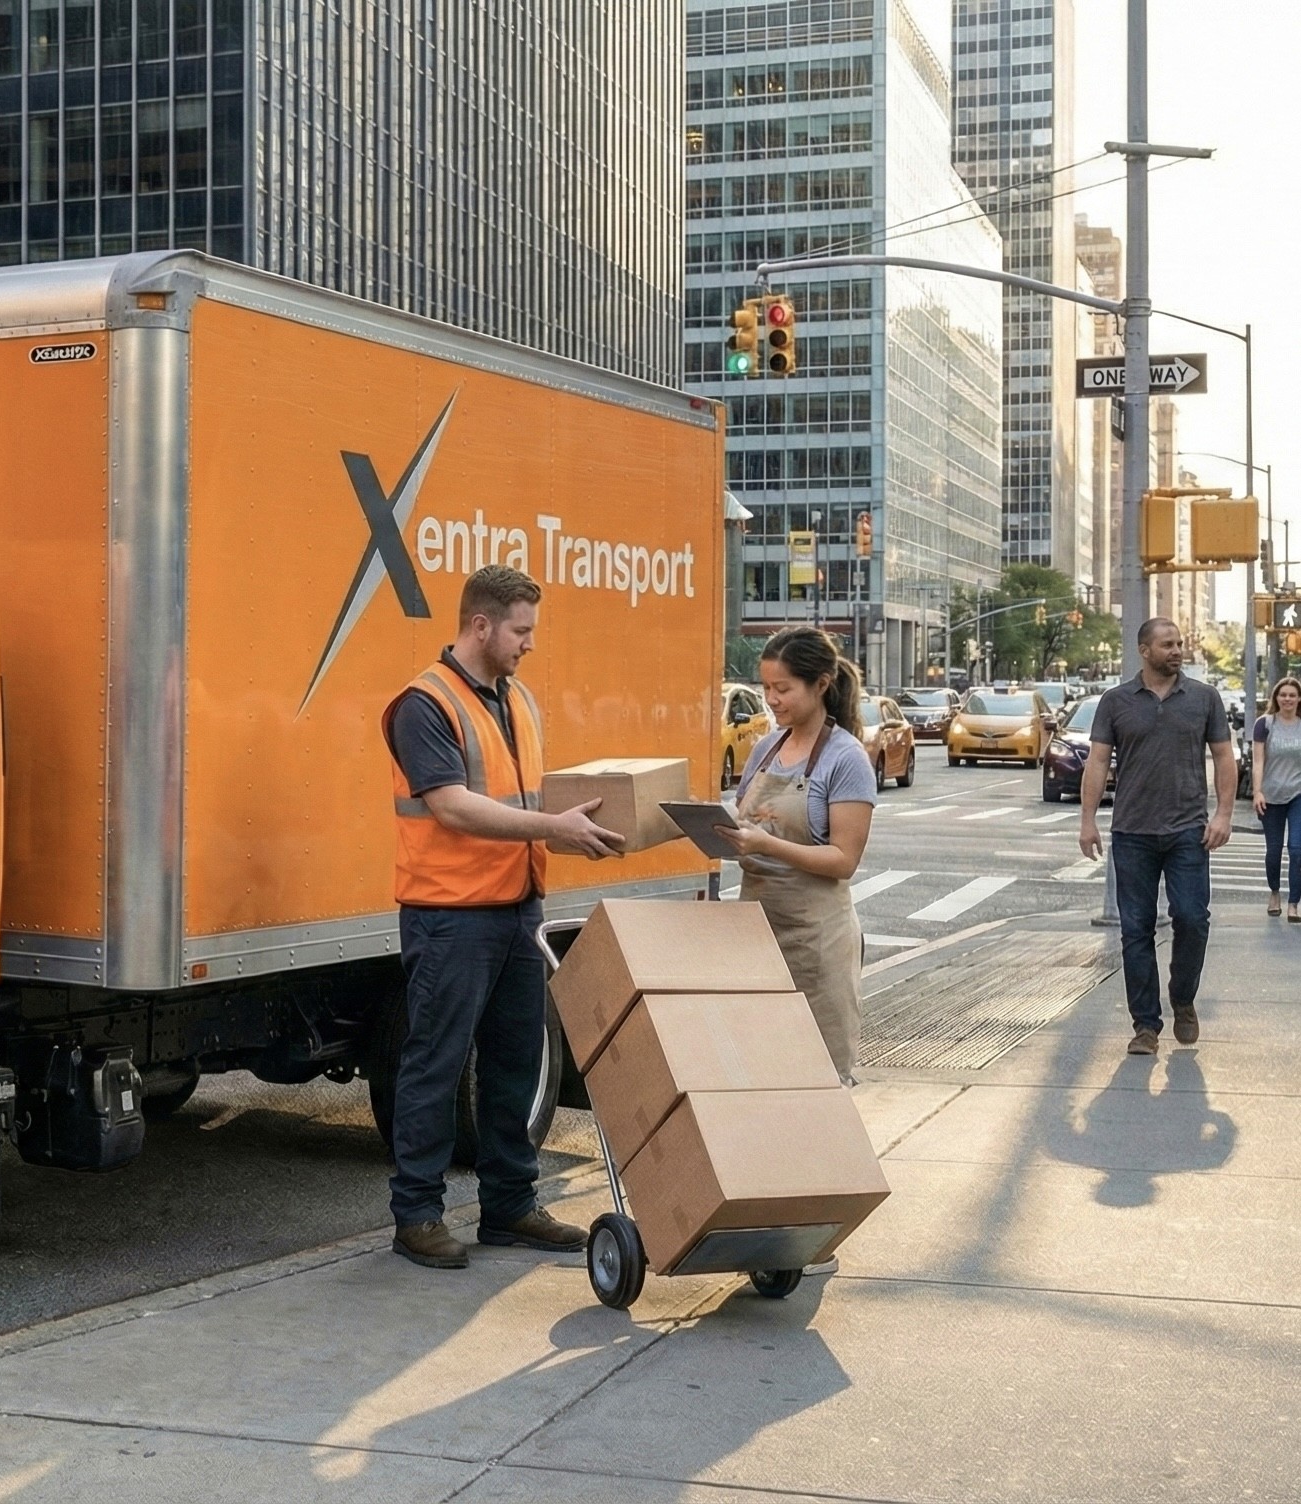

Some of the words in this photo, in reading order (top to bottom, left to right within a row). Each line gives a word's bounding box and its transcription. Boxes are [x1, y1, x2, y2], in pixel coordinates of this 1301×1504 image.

[1092, 369, 1125, 386] ONE
[1149, 366, 1189, 383] WAY
[295, 384, 529, 722] Xentra
[537, 514, 694, 607] Transport
